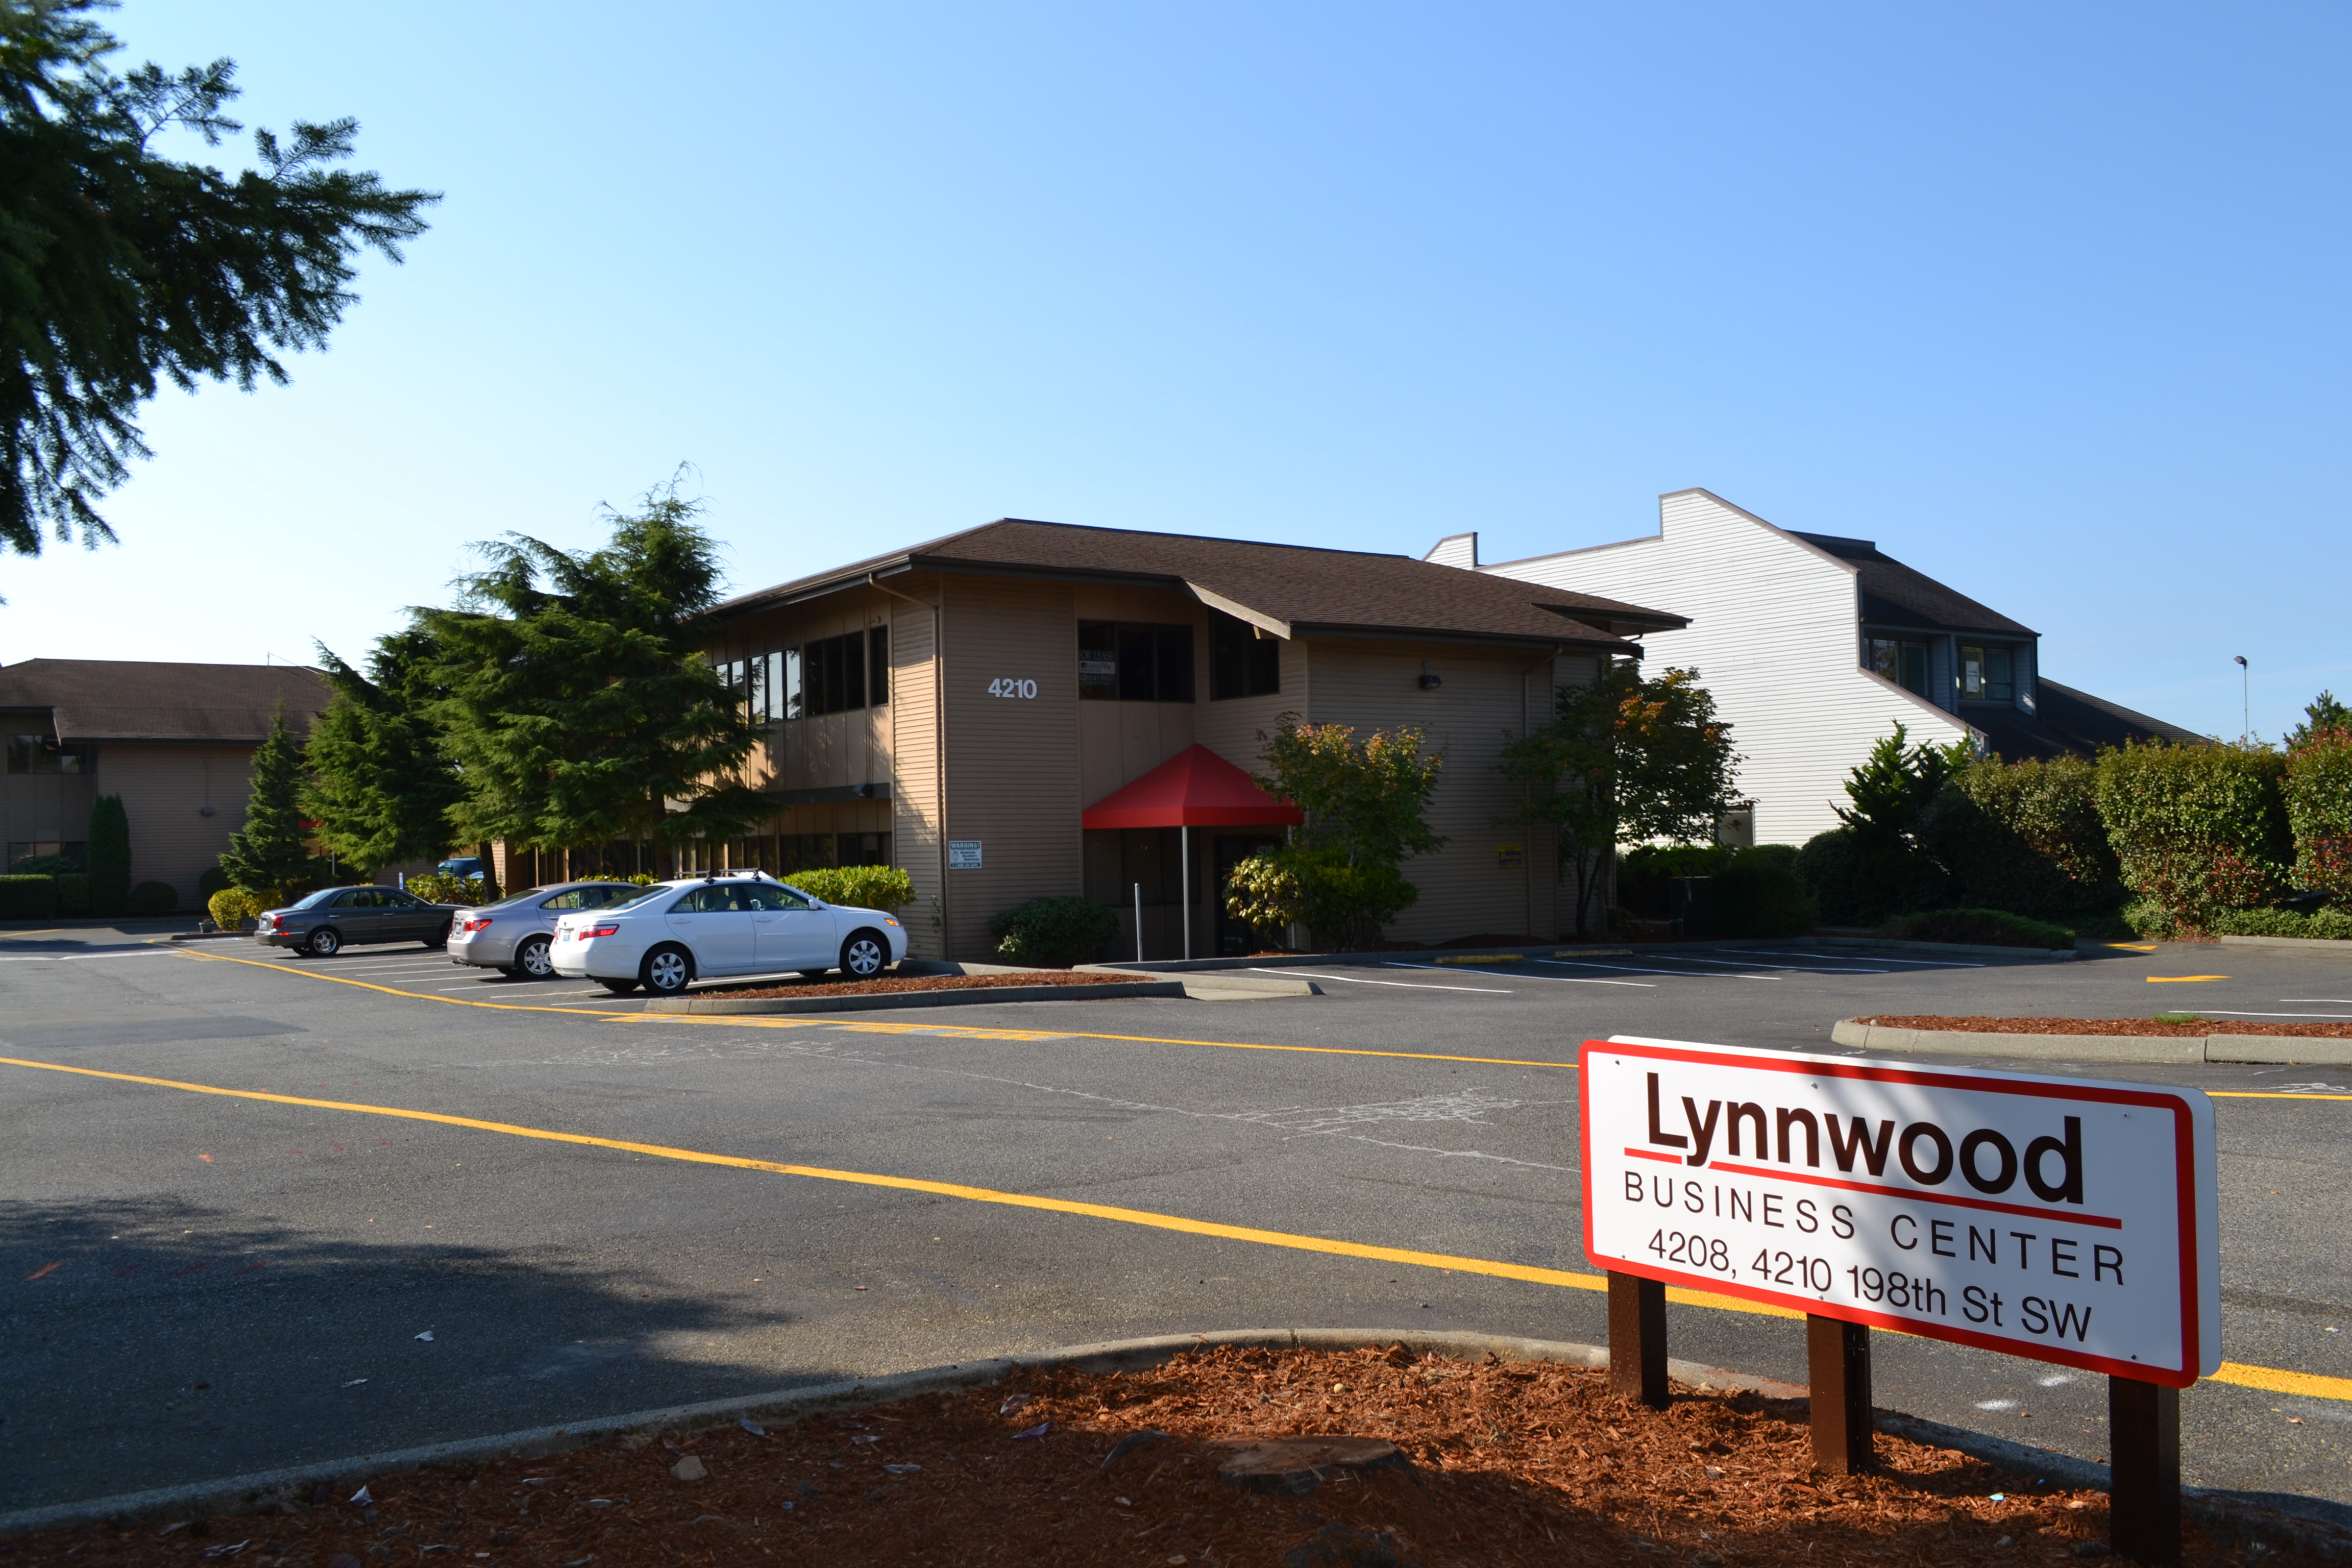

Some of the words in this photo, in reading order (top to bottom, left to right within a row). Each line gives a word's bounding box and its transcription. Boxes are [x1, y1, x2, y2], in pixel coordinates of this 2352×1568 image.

[988, 678, 1037, 699] 4210
[1093, 651, 1114, 660] LEASE
[1256, 846, 1272, 855] 4210
[1647, 1072, 2084, 1206] Lynnwood
[1625, 1171, 1855, 1239] BUSINESS
[1890, 1214, 2124, 1286] CENTER
[1648, 1229, 1736, 1280] 4208,
[1752, 1248, 1832, 1292] 4210
[1846, 1265, 1947, 1316] 198th
[1962, 1285, 2004, 1328] St
[2020, 1295, 2093, 1343] SW
